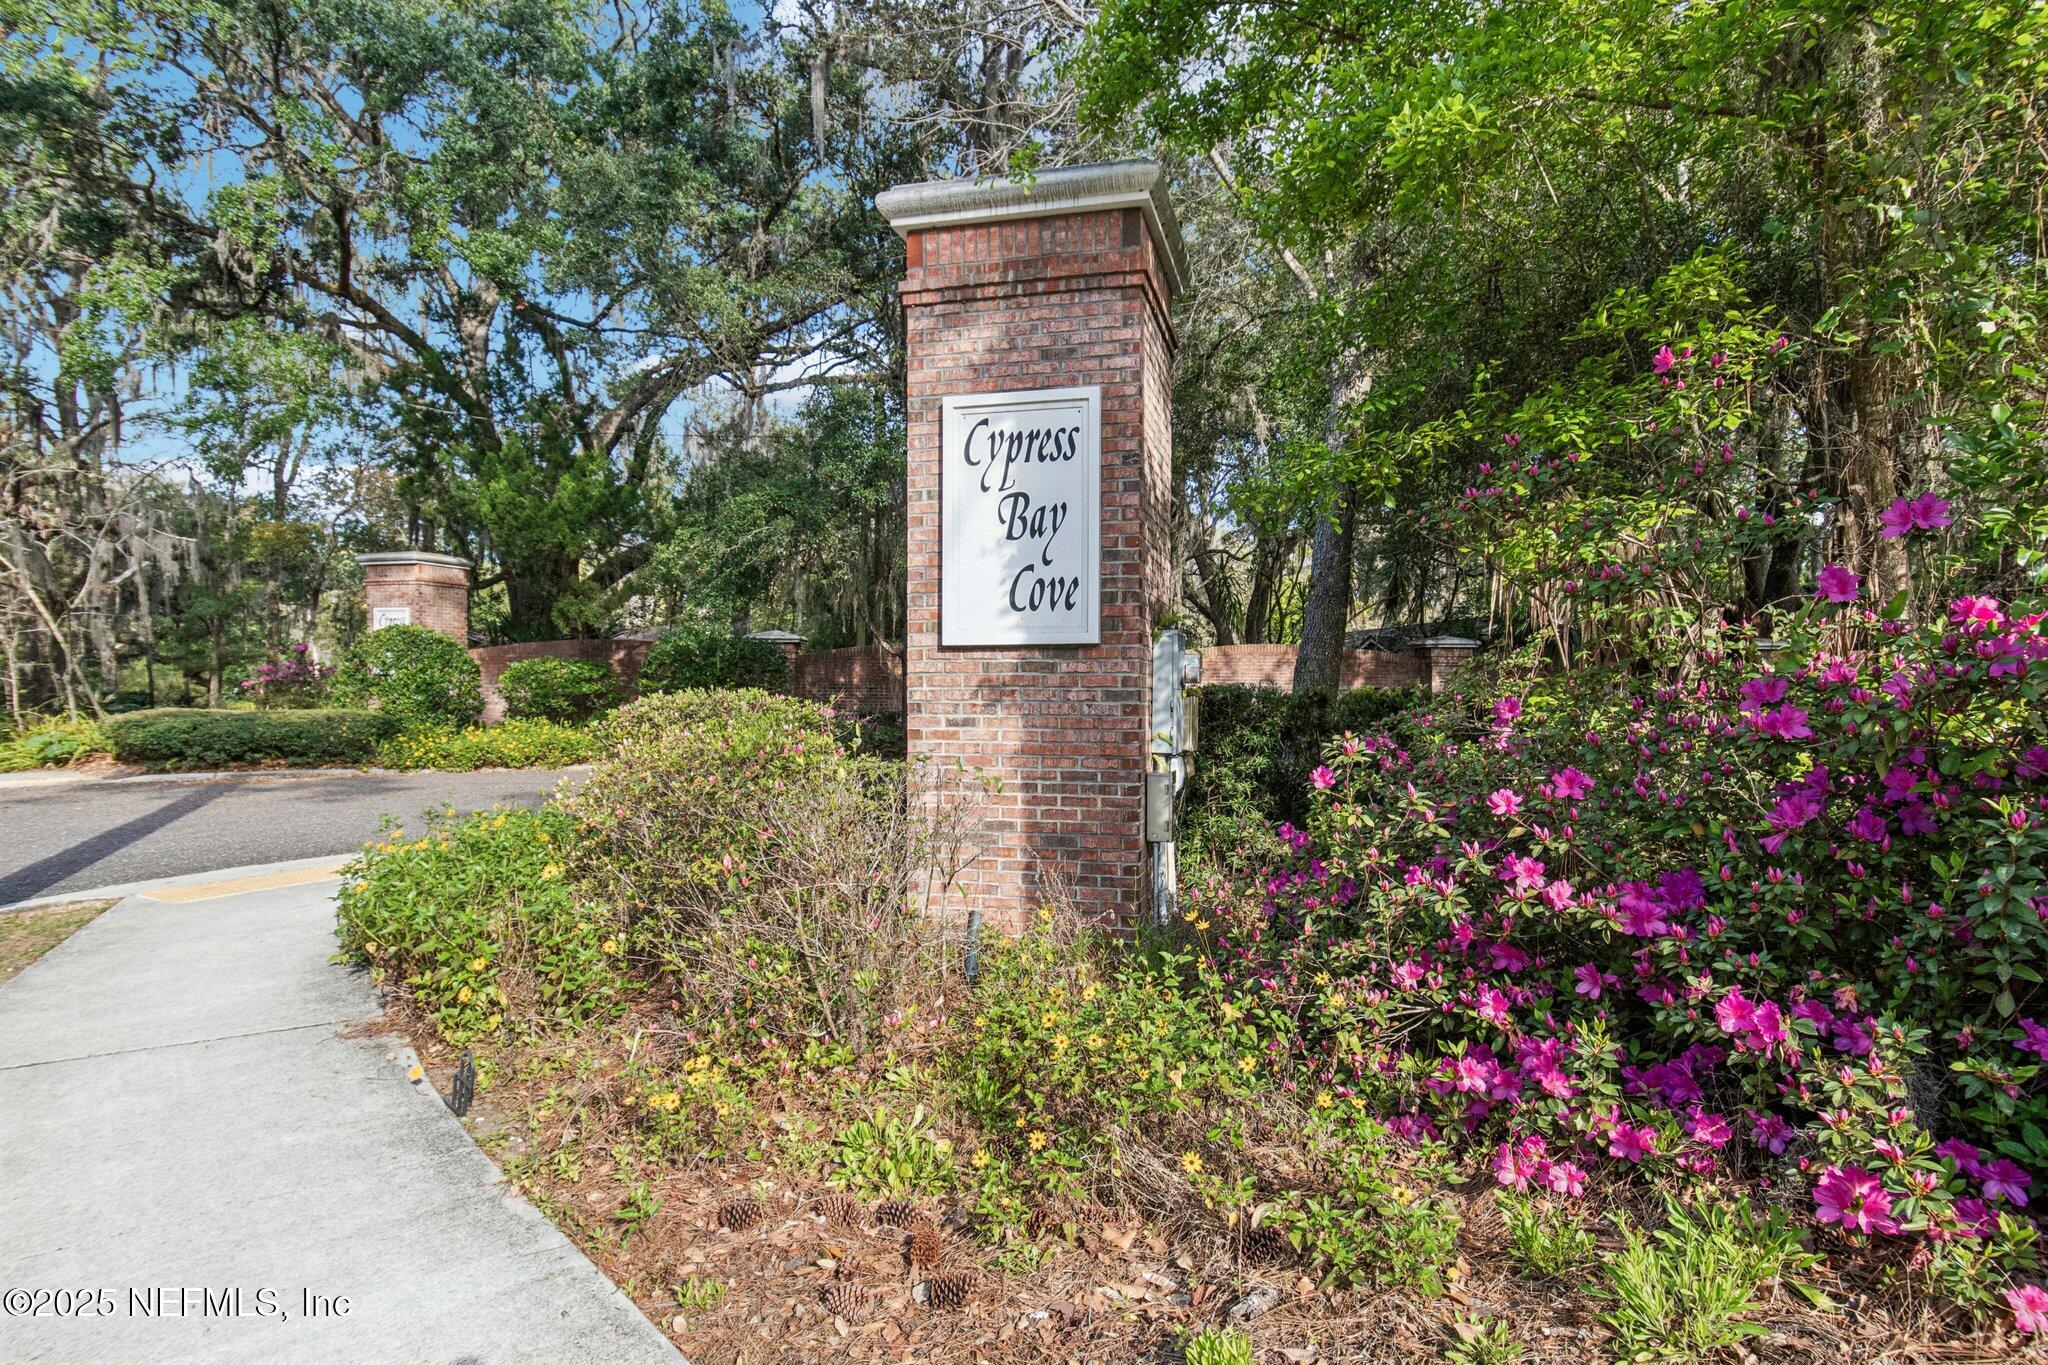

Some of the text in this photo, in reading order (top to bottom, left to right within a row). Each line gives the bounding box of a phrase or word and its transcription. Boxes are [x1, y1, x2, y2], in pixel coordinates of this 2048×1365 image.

[964, 418, 1080, 492] Cypress
[998, 492, 1067, 566] Bay
[1009, 563, 1079, 612] Cove
